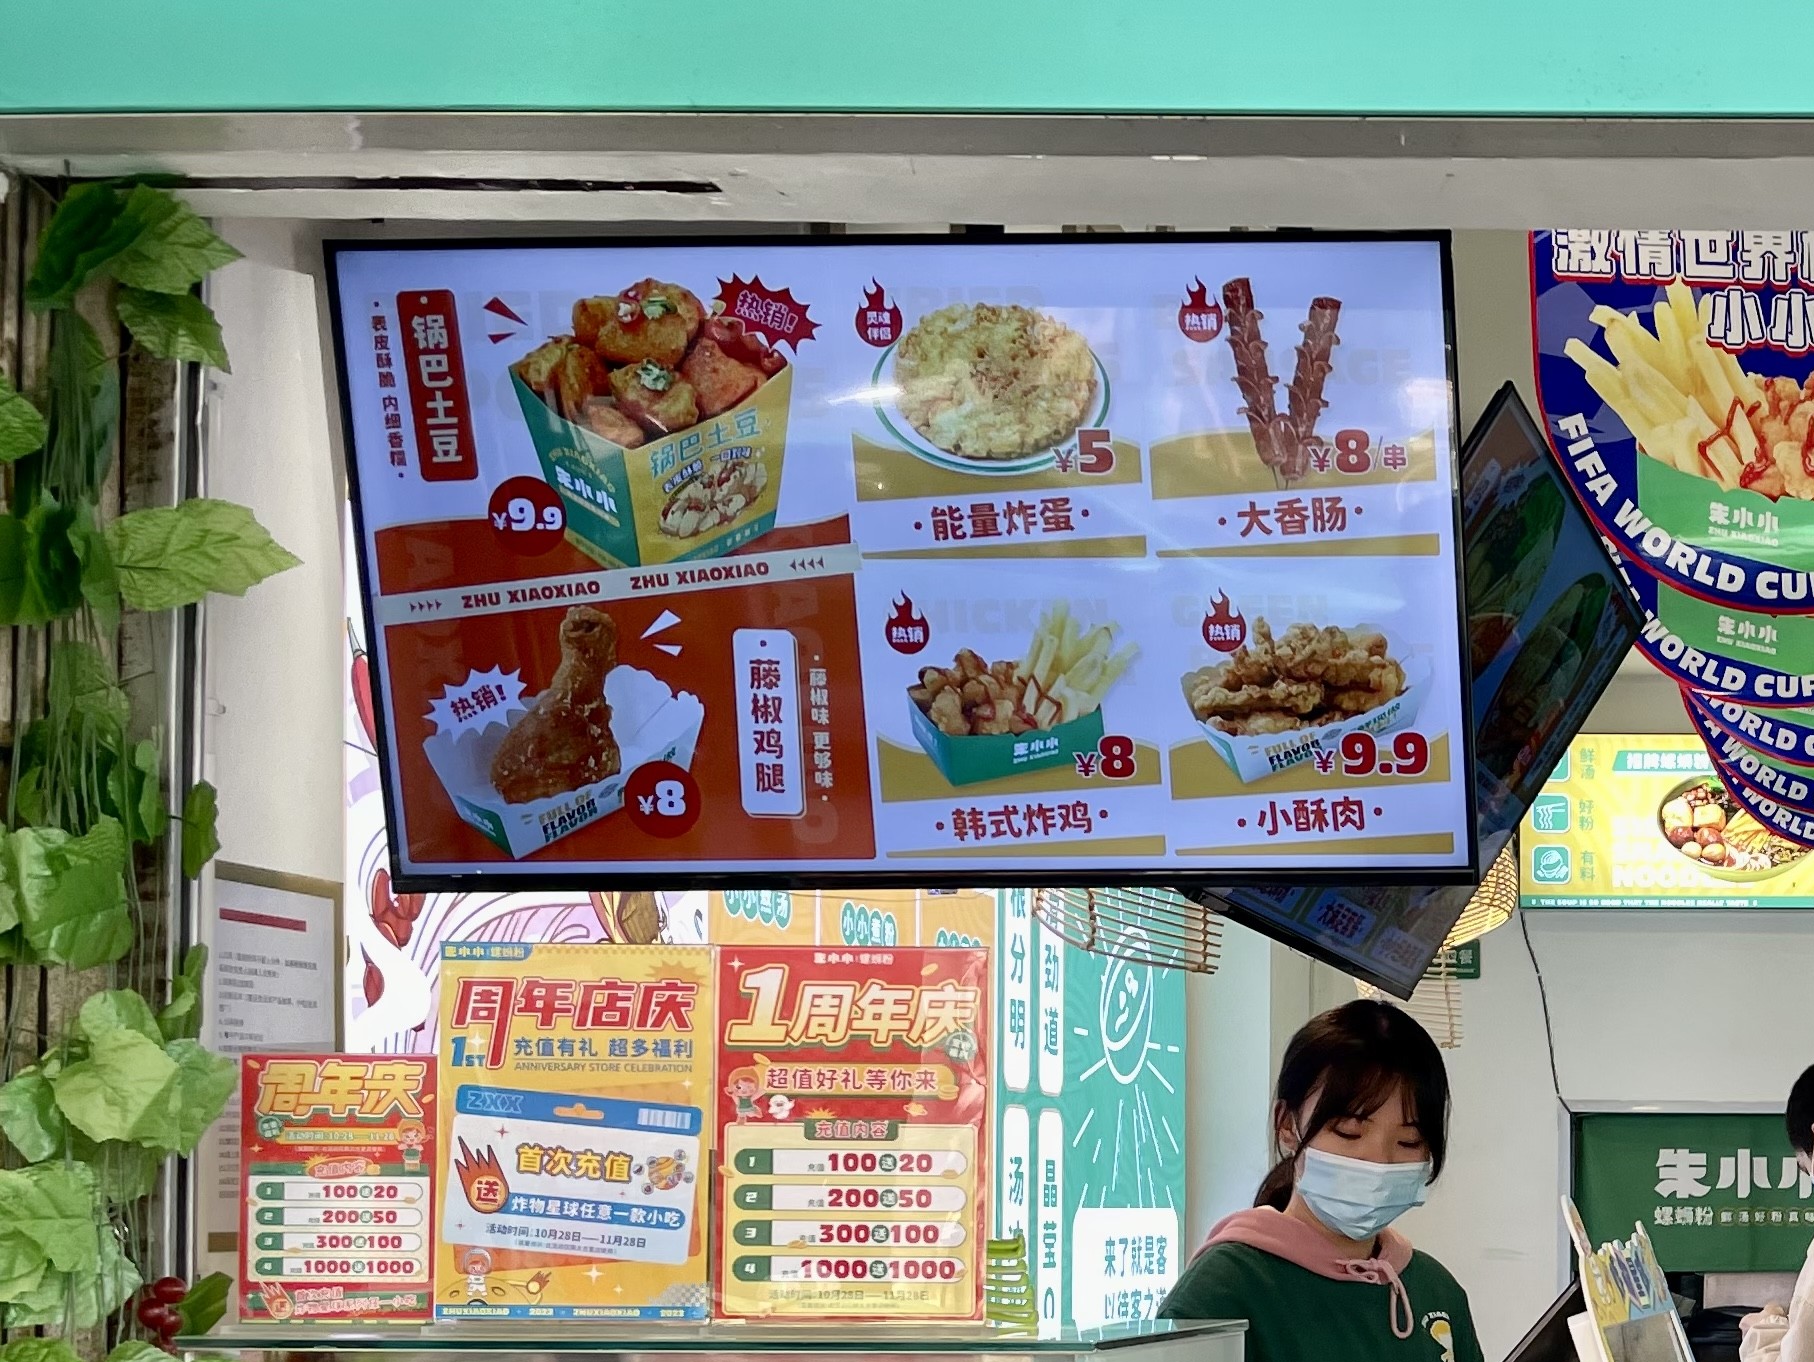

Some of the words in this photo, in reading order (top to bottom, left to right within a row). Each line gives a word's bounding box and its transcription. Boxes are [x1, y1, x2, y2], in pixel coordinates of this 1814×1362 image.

[735, 290, 799, 335] 热销!
[1183, 311, 1219, 332] 热销
[411, 314, 463, 463] 锅巴土豆
[1053, 429, 1115, 474] ¥5
[492, 497, 563, 533] ¥9.9
[930, 497, 1077, 540] 能量炸蛋
[1237, 497, 1349, 537] 大香肠
[1556, 412, 1620, 508] FIFA
[1612, 498, 1748, 594] WORLD
[462, 594, 501, 609] ZHU
[507, 581, 600, 604] XIAOXIAO
[631, 575, 670, 590] ZHU
[677, 561, 769, 585] XIAOXIAO
[891, 626, 924, 645] 热销
[1207, 625, 1242, 643] 热销
[1641, 615, 1748, 694] WORLD
[449, 684, 507, 724] 热销!
[809, 667, 831, 725] 藤椒味
[749, 658, 786, 793] 藤椒鸡腿
[812, 731, 834, 789] 更够味
[1075, 735, 1137, 779] ¥8
[1313, 731, 1430, 776] ¥9.9
[1720, 737, 1810, 803] WORLD
[639, 780, 687, 817] ¥8
[1257, 797, 1366, 836] 小酥肉
[951, 801, 1094, 842] 韩式炸鸡
[451, 976, 699, 1069] 周年店庆
[726, 963, 981, 1047] 1周年庆
[513, 1036, 599, 1058] 充值有礼
[607, 1038, 694, 1060] 超多福利
[514, 1061, 587, 1073] ANNIVERSARY
[589, 1061, 621, 1073] STORE
[624, 1062, 693, 1074] CELEBRATION
[257, 1059, 428, 1119] 周年庆
[765, 1067, 938, 1092] 超值好礼等你来
[815, 1119, 890, 1139] 充值内容
[515, 1142, 634, 1184] 首次充值
[476, 1180, 499, 1205] 送
[511, 1196, 682, 1229] 炸物星球任意一款小吃
[1653, 1205, 1714, 1226] 螺蛳粉
[1104, 1234, 1168, 1277] 来了就是客
